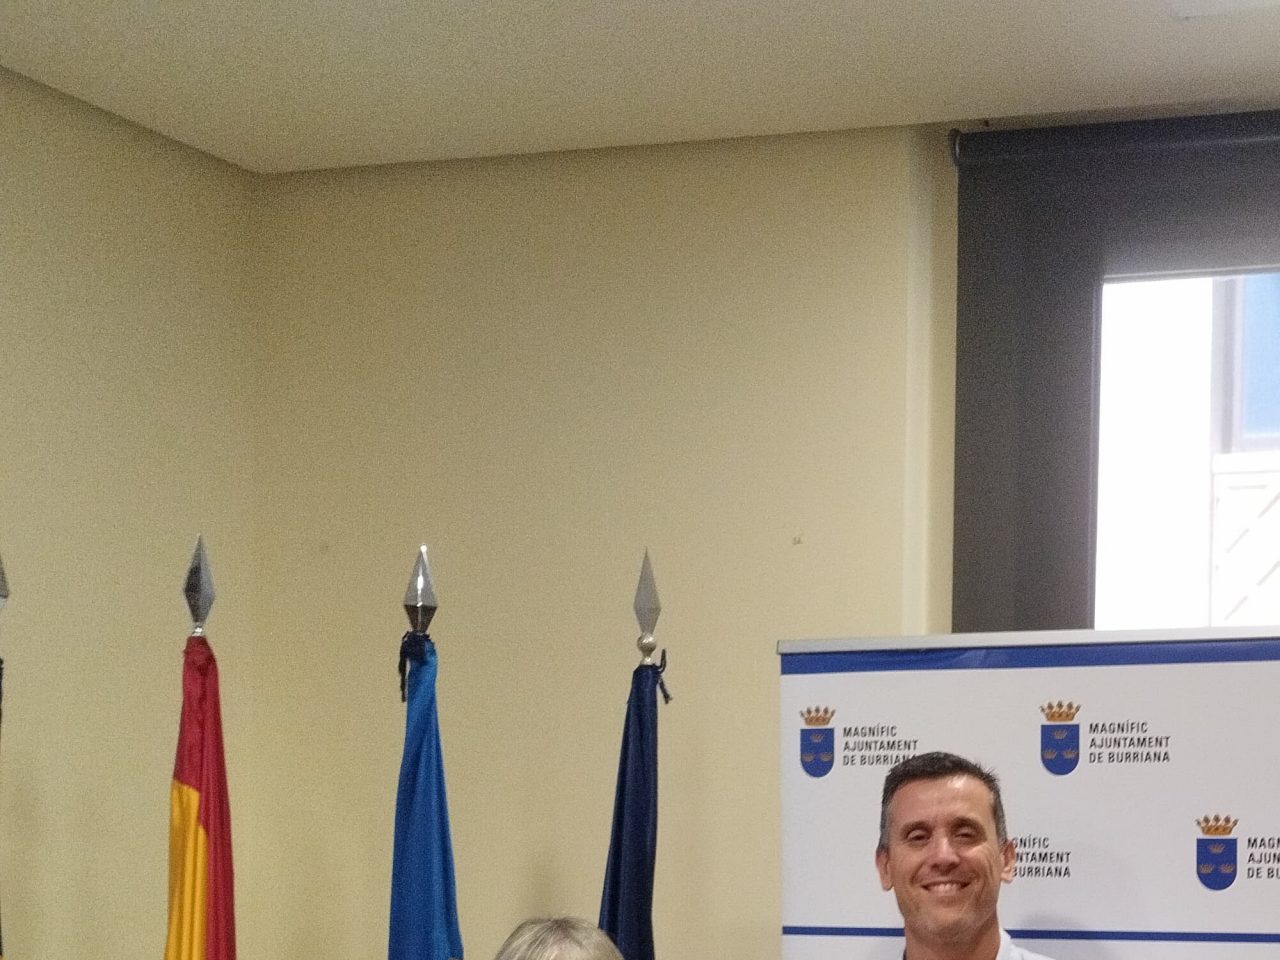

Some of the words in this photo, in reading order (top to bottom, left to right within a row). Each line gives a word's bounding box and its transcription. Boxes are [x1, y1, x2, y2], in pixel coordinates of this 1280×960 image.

[842, 723, 897, 737] MAGNÍFIC
[1088, 719, 1149, 734] MAGNÍFIC
[843, 740, 919, 752] AJUNTAMENT
[1089, 736, 1171, 749] AJUNTAMENT
[843, 755, 857, 766] DE
[1089, 752, 1104, 763] DE
[1107, 751, 1170, 763] BURRIANA
[1247, 867, 1262, 879] DE
